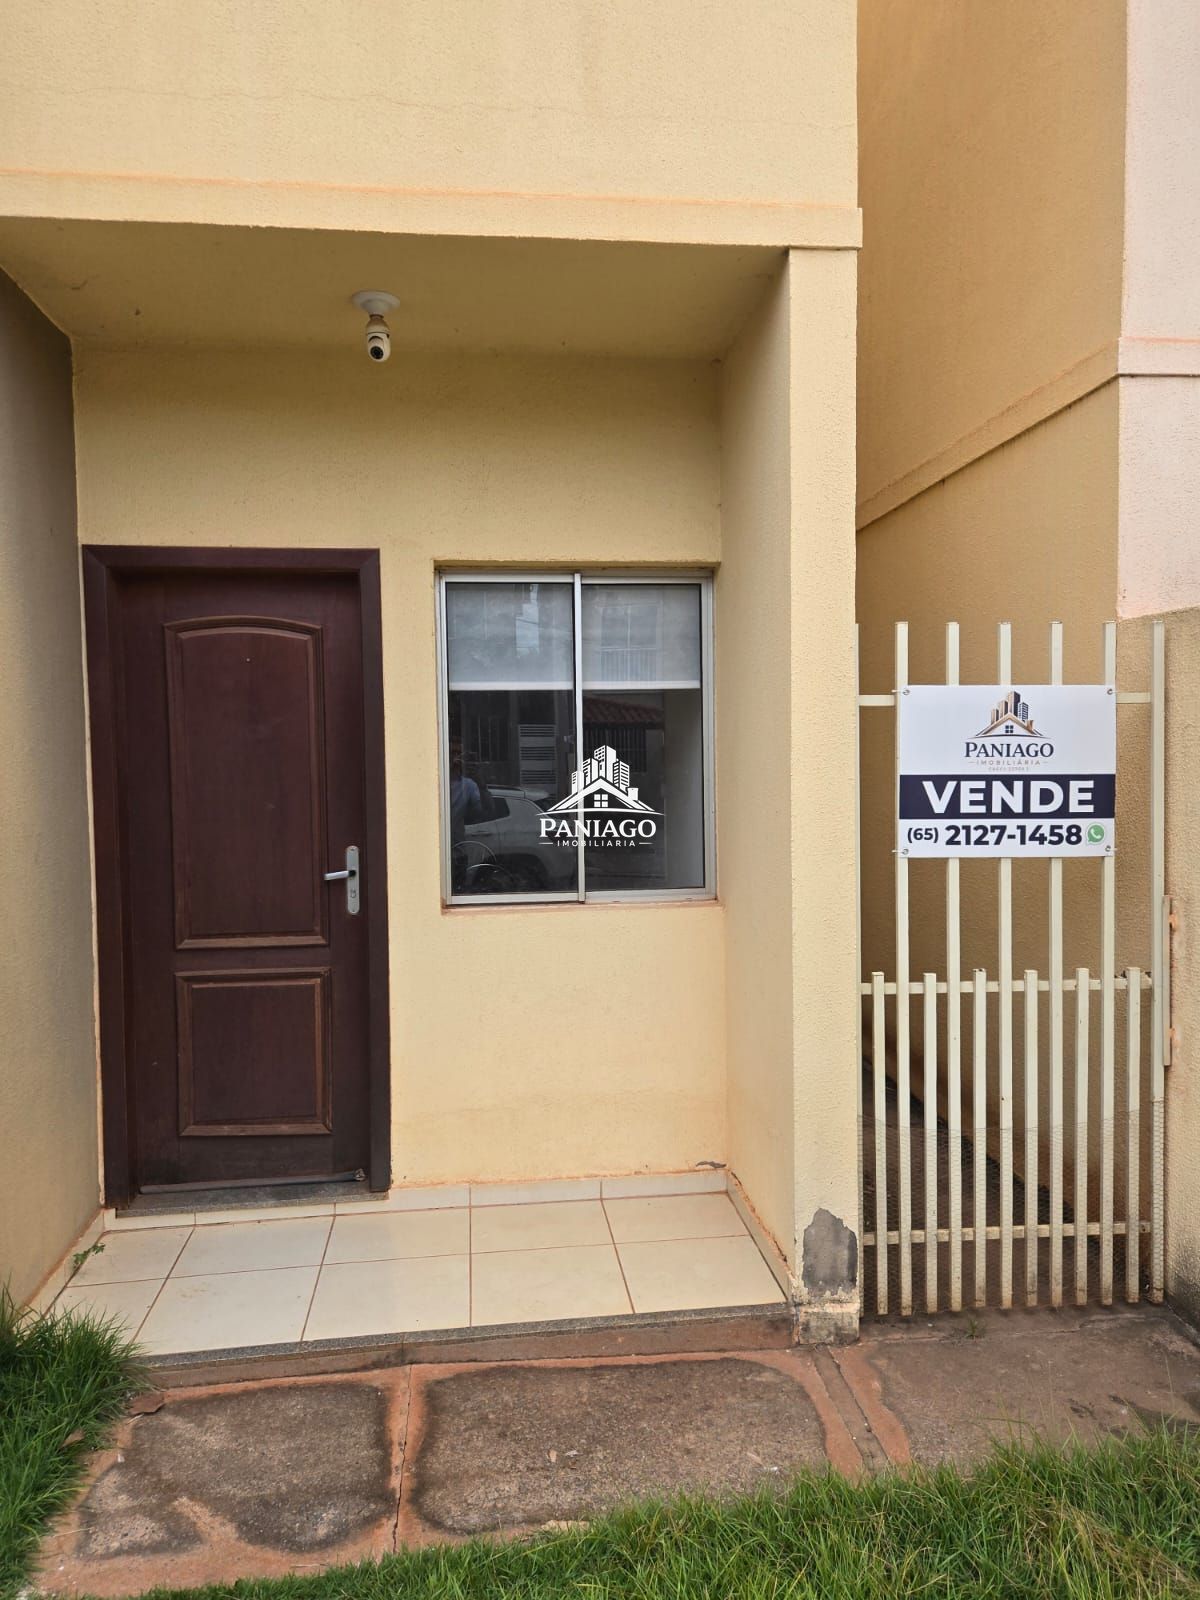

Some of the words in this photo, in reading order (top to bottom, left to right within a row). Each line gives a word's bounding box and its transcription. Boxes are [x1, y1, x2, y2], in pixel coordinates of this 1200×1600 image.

[965, 742, 1054, 757] PANIAGO
[922, 780, 1095, 814] VENDE
[907, 827, 939, 844] (65)
[945, 824, 1082, 846] 2127-1458
